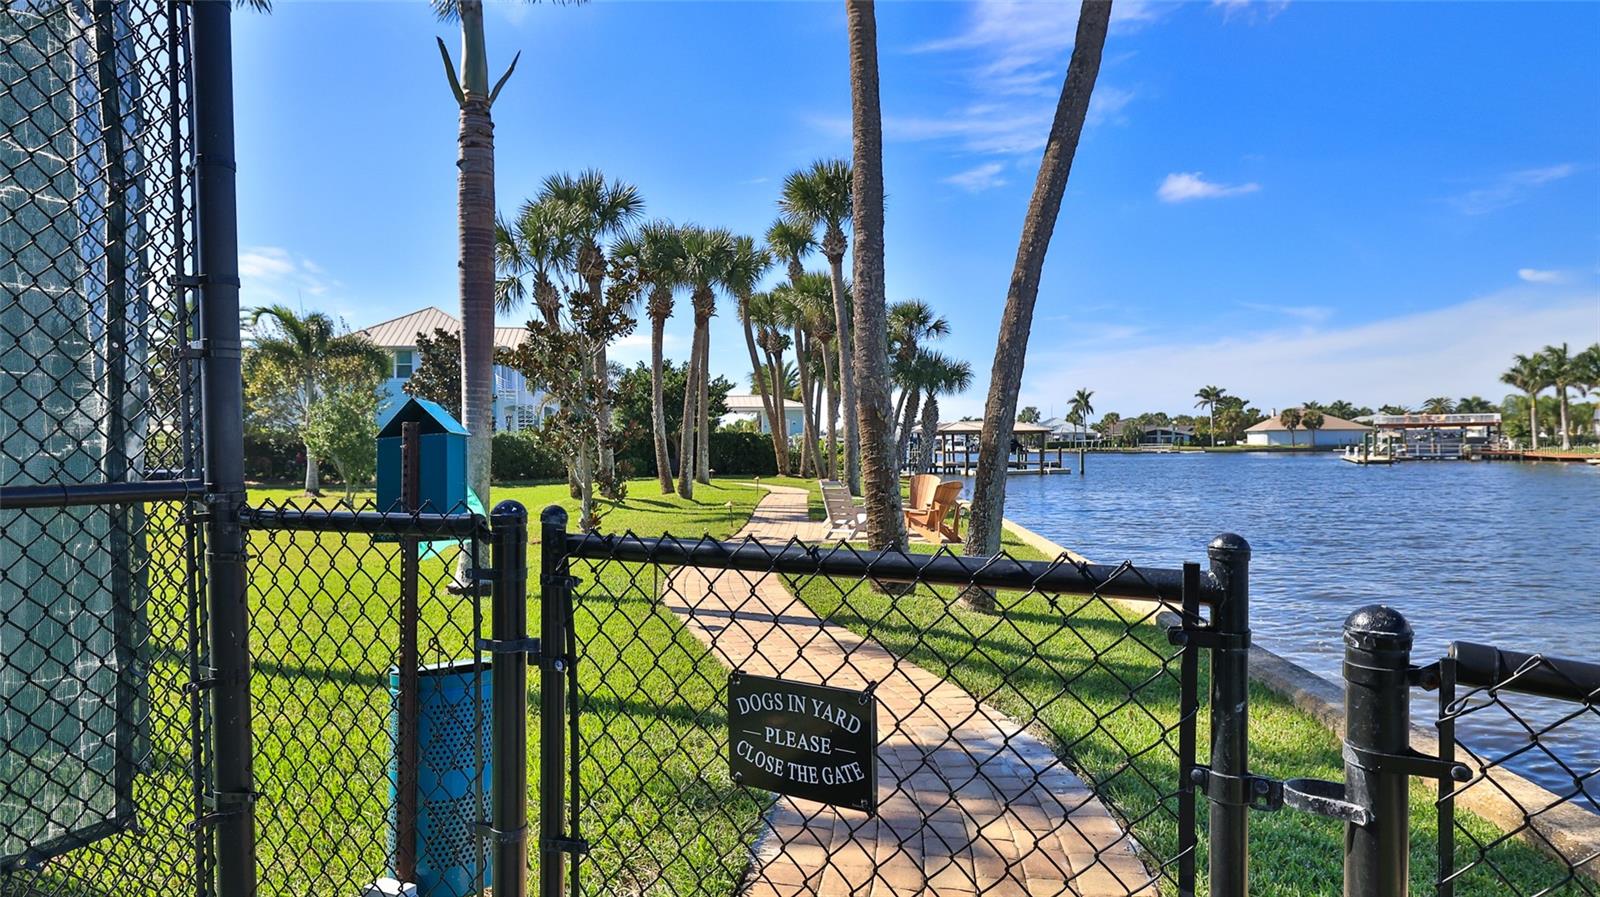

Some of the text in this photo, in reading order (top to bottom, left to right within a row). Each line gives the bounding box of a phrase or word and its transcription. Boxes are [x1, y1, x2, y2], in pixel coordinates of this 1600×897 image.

[736, 692, 862, 734] DOGS IN YARD
[764, 726, 832, 755] PLEASE
[736, 740, 865, 785] CLOSE THE GATE
